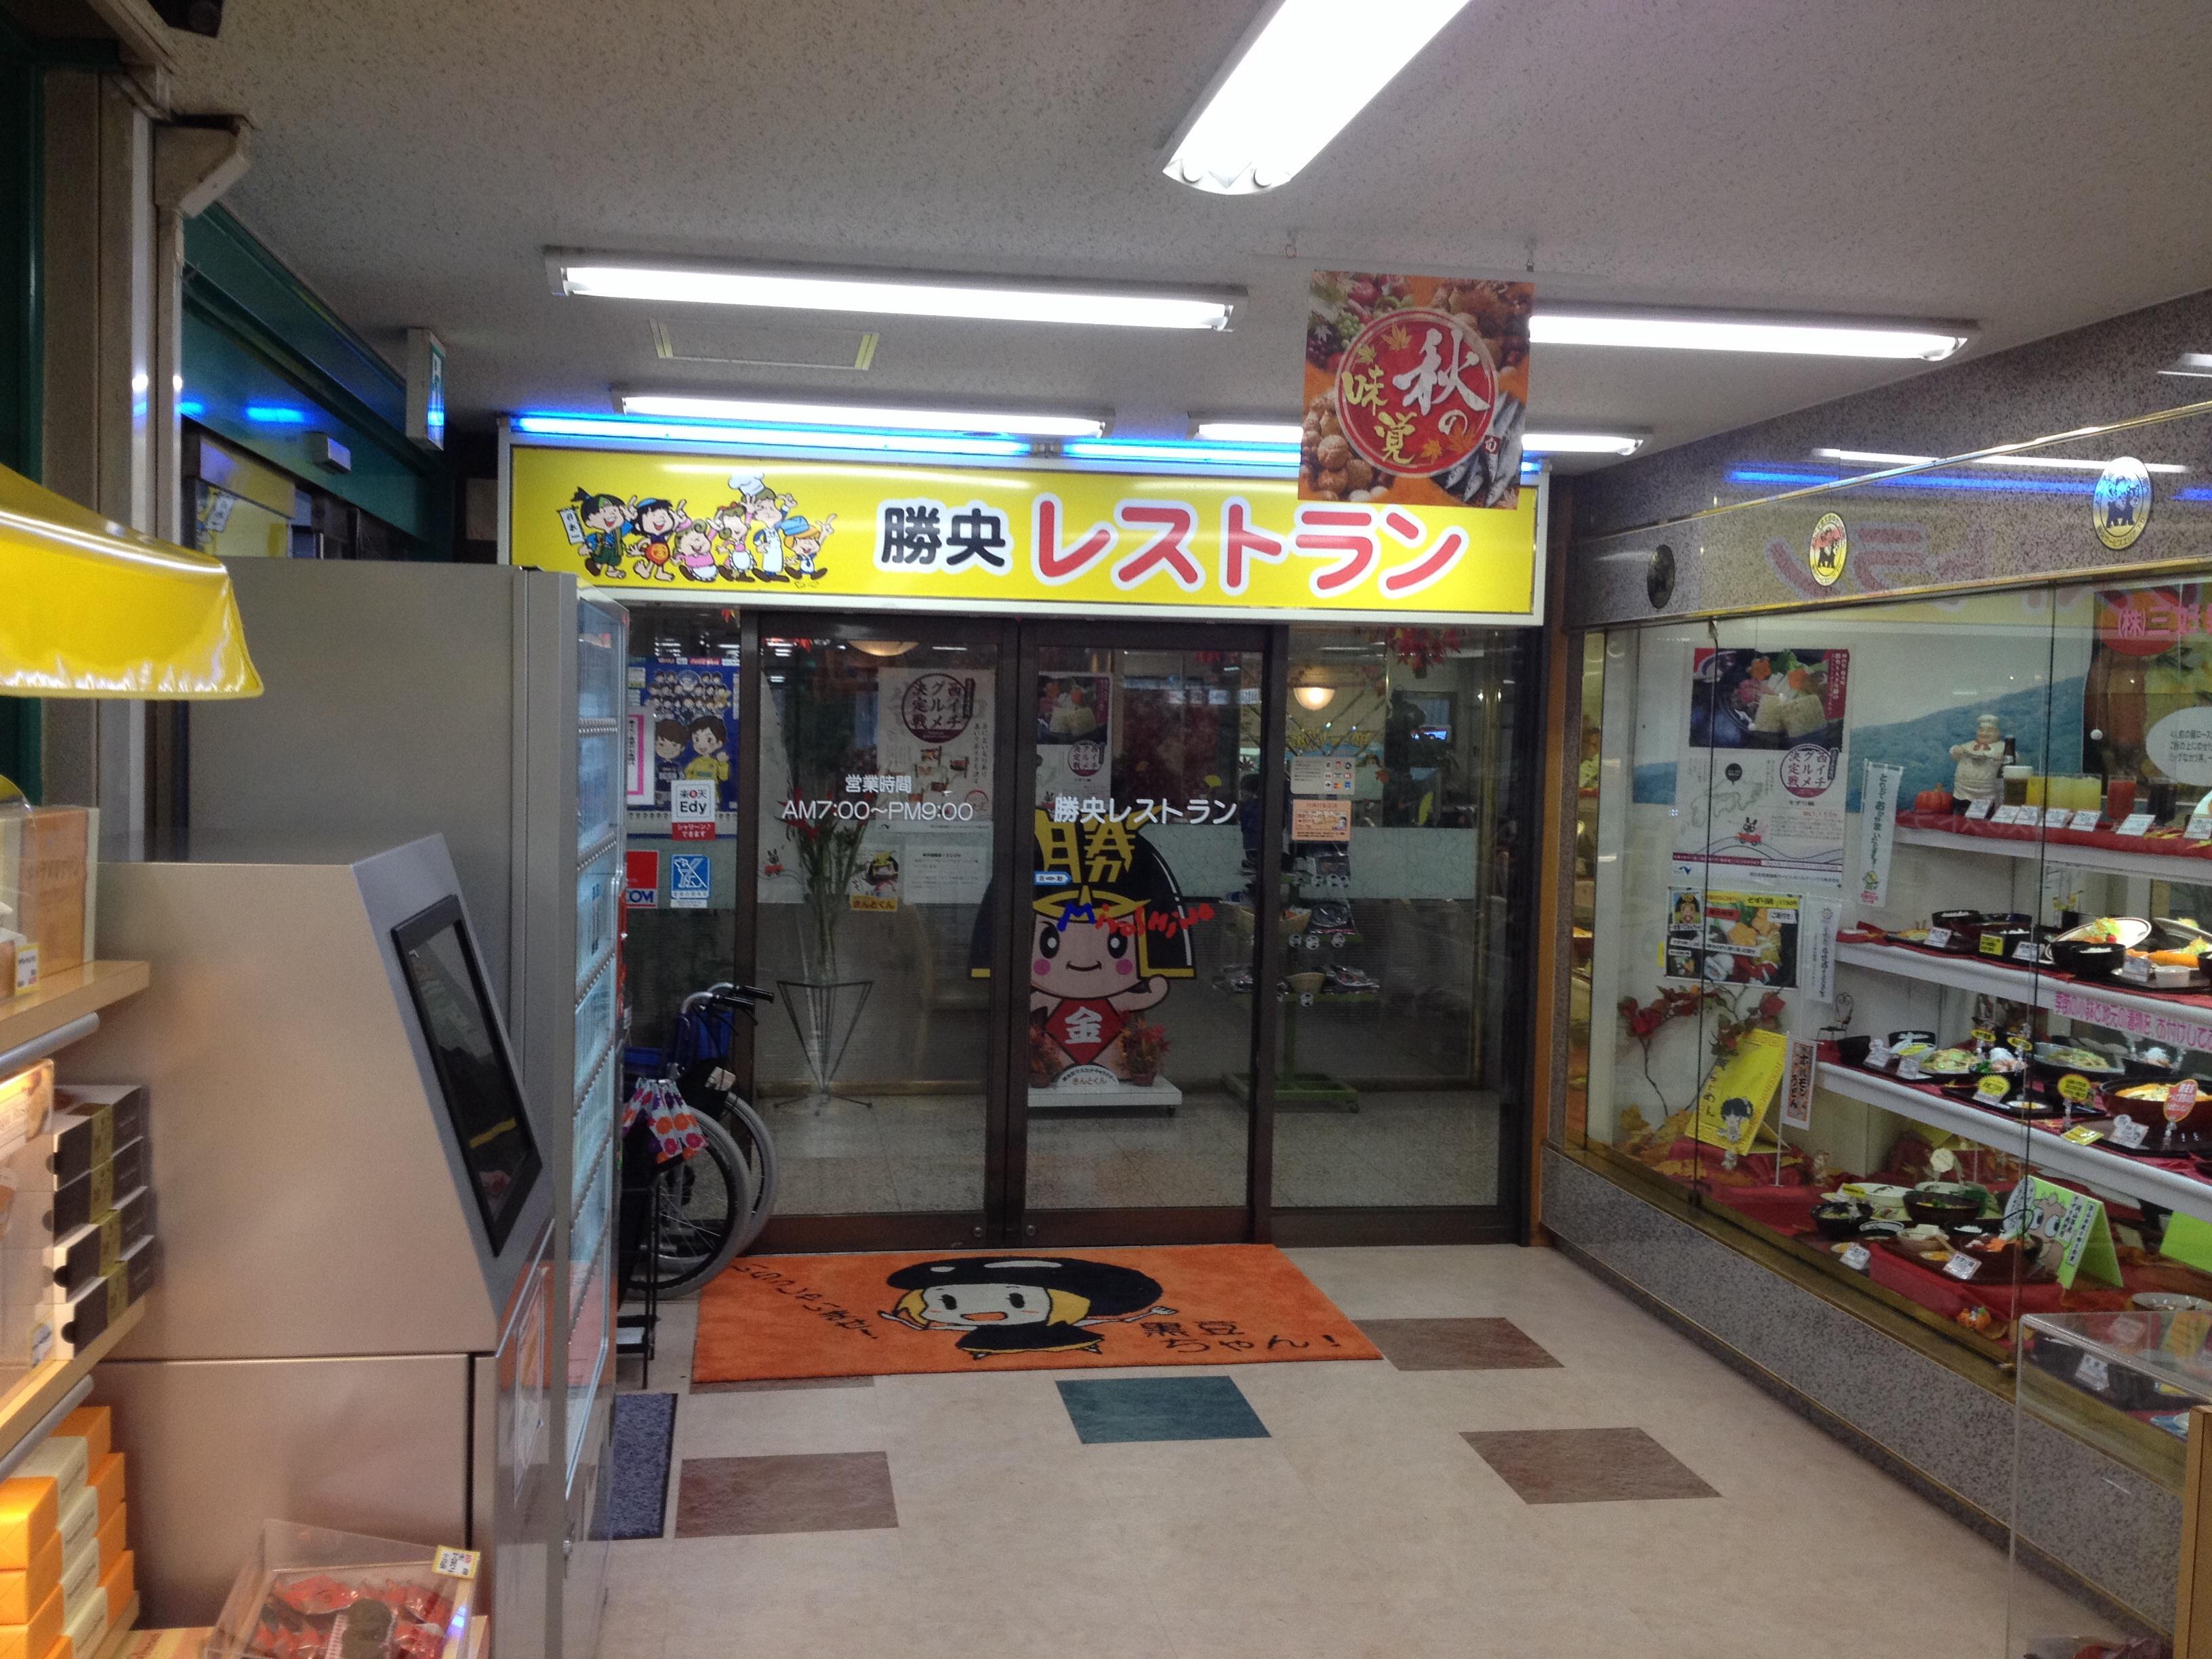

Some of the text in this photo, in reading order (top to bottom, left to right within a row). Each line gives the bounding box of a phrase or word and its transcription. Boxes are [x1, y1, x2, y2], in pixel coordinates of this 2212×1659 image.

[845, 774, 912, 794] 営業時間
[680, 800, 707, 815] Edy
[1054, 793, 1237, 825] 勝央レストラン
[1065, 1006, 1103, 1044] 金
[1140, 1321, 1244, 1337] 黒豆
